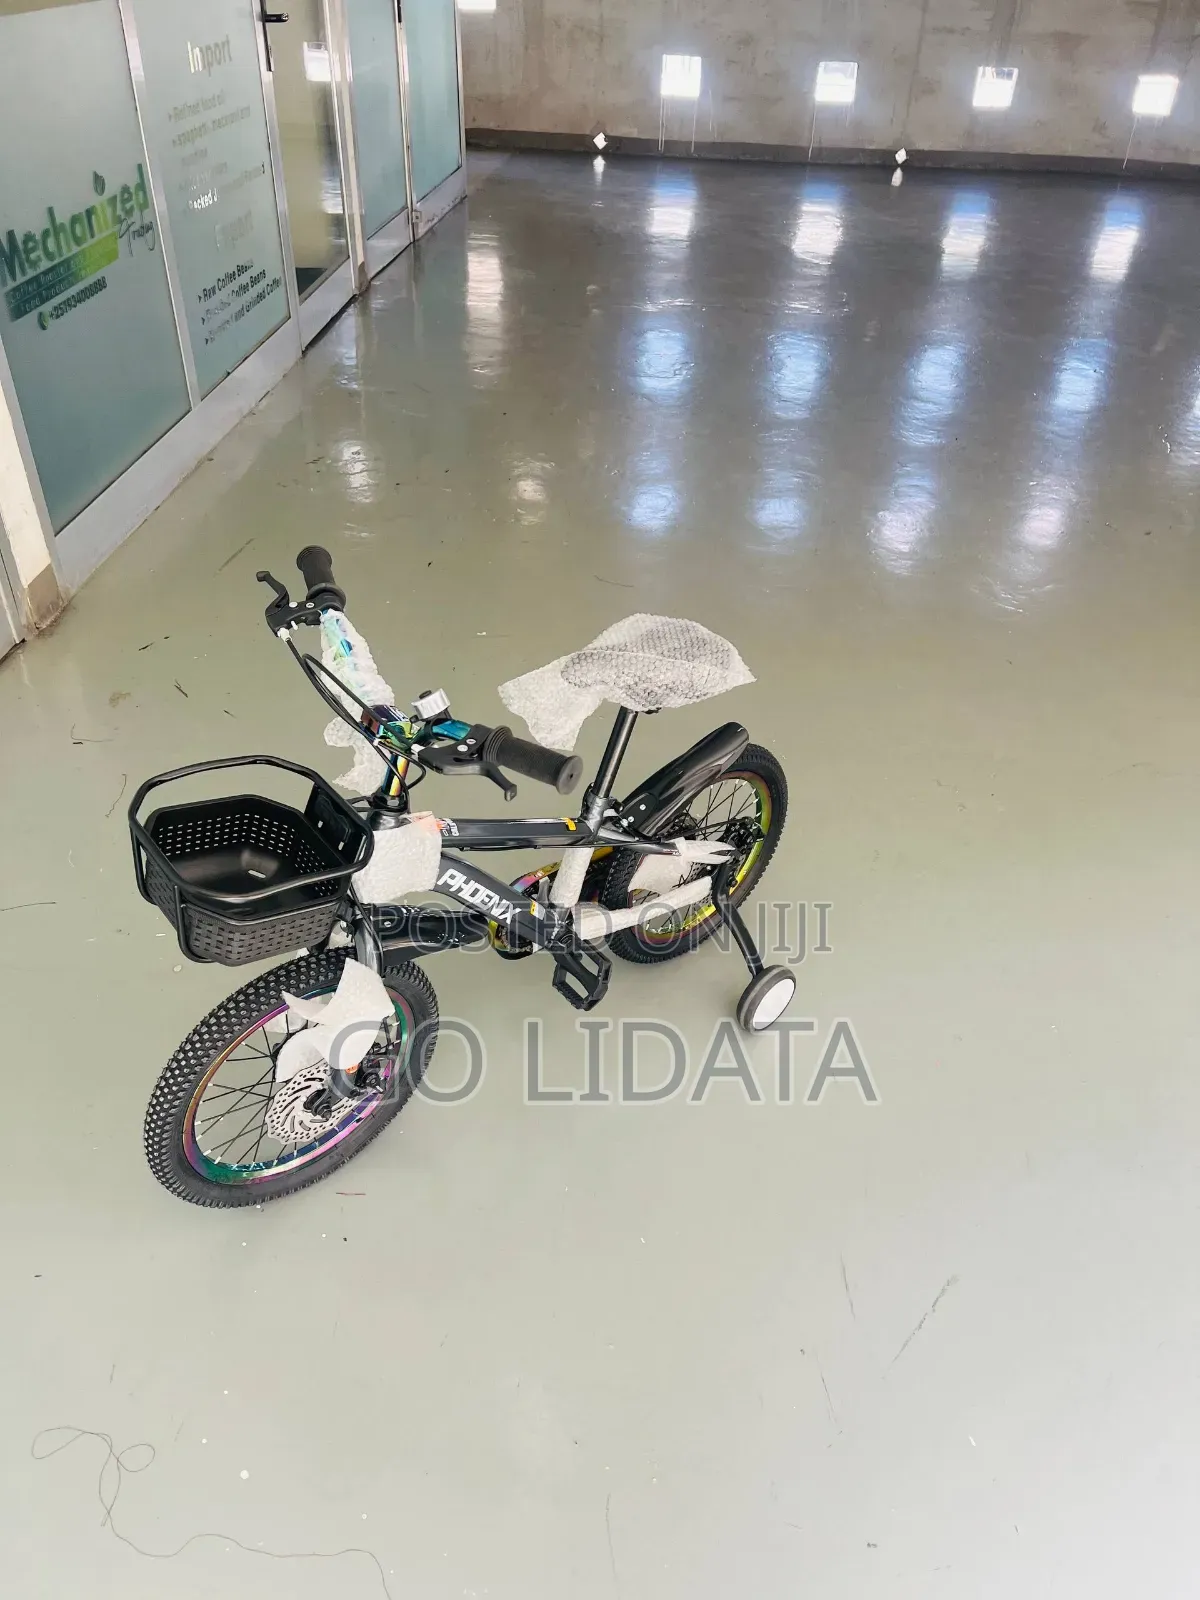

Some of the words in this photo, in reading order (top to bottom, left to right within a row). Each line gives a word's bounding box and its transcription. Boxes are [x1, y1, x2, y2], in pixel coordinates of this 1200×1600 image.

[187, 34, 233, 77] Import
[0, 164, 150, 288] Mechanized
[202, 286, 217, 302] Raw
[216, 270, 237, 291] Coffee
[231, 281, 250, 299] Coffee
[249, 268, 267, 288] Beans
